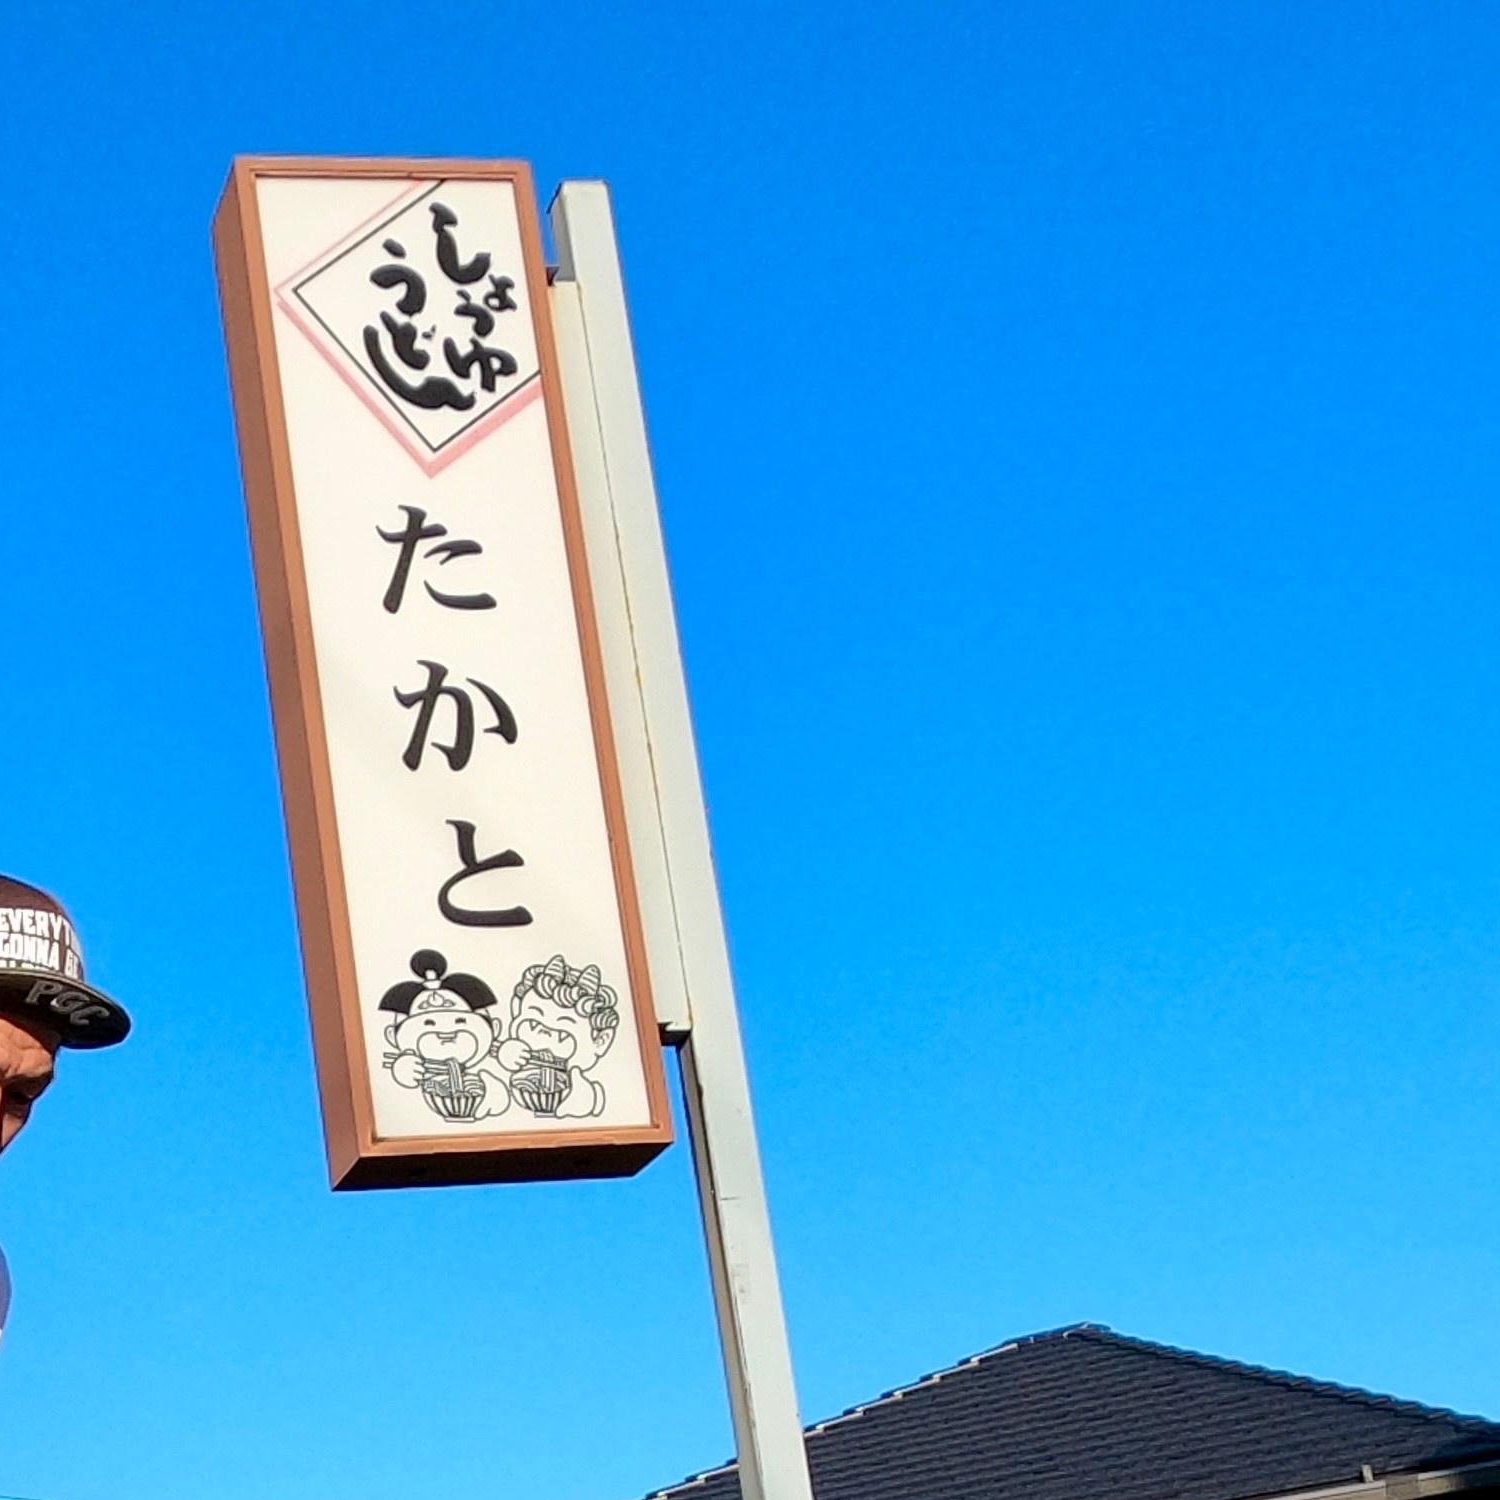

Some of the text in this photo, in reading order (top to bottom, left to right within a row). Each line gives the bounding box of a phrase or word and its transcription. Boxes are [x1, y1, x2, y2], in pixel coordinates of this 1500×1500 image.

[362, 237, 477, 411] うどん
[428, 201, 519, 393] しょうゆ
[374, 504, 534, 928] たかと
